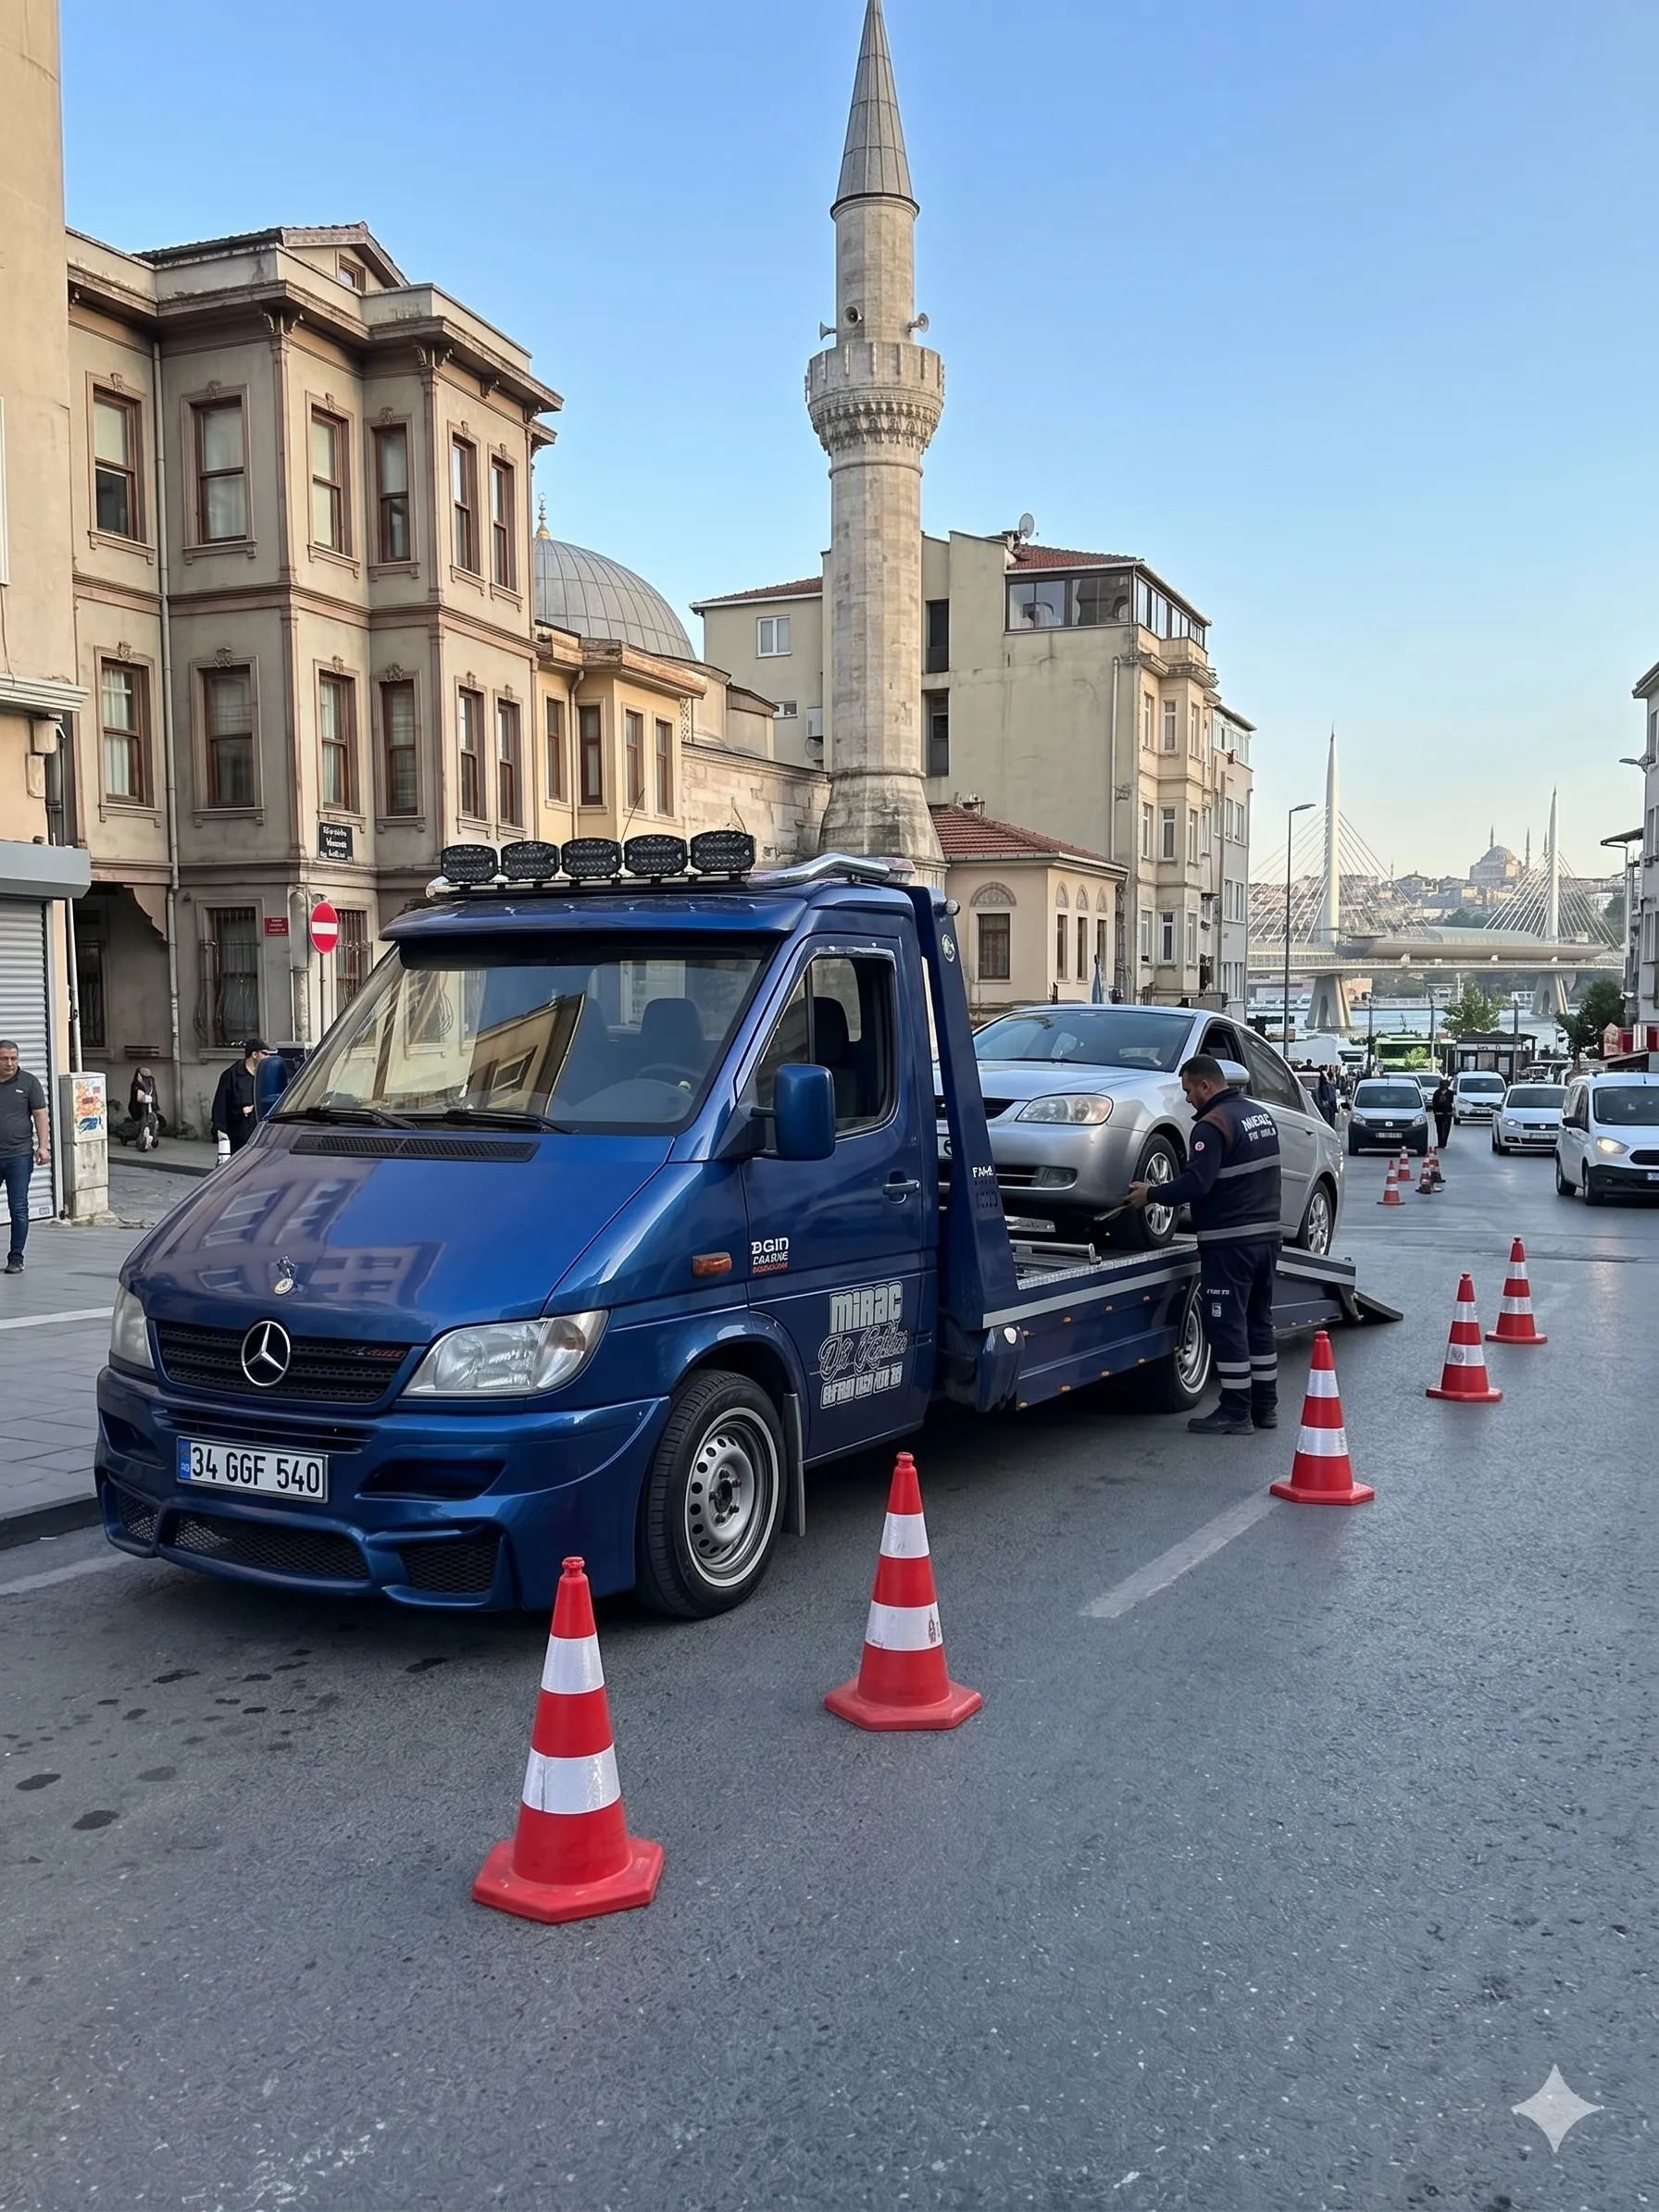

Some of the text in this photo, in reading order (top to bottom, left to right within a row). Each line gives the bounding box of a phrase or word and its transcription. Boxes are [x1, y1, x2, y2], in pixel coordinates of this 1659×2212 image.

[192, 1446, 319, 1494] 34 GGF 540
